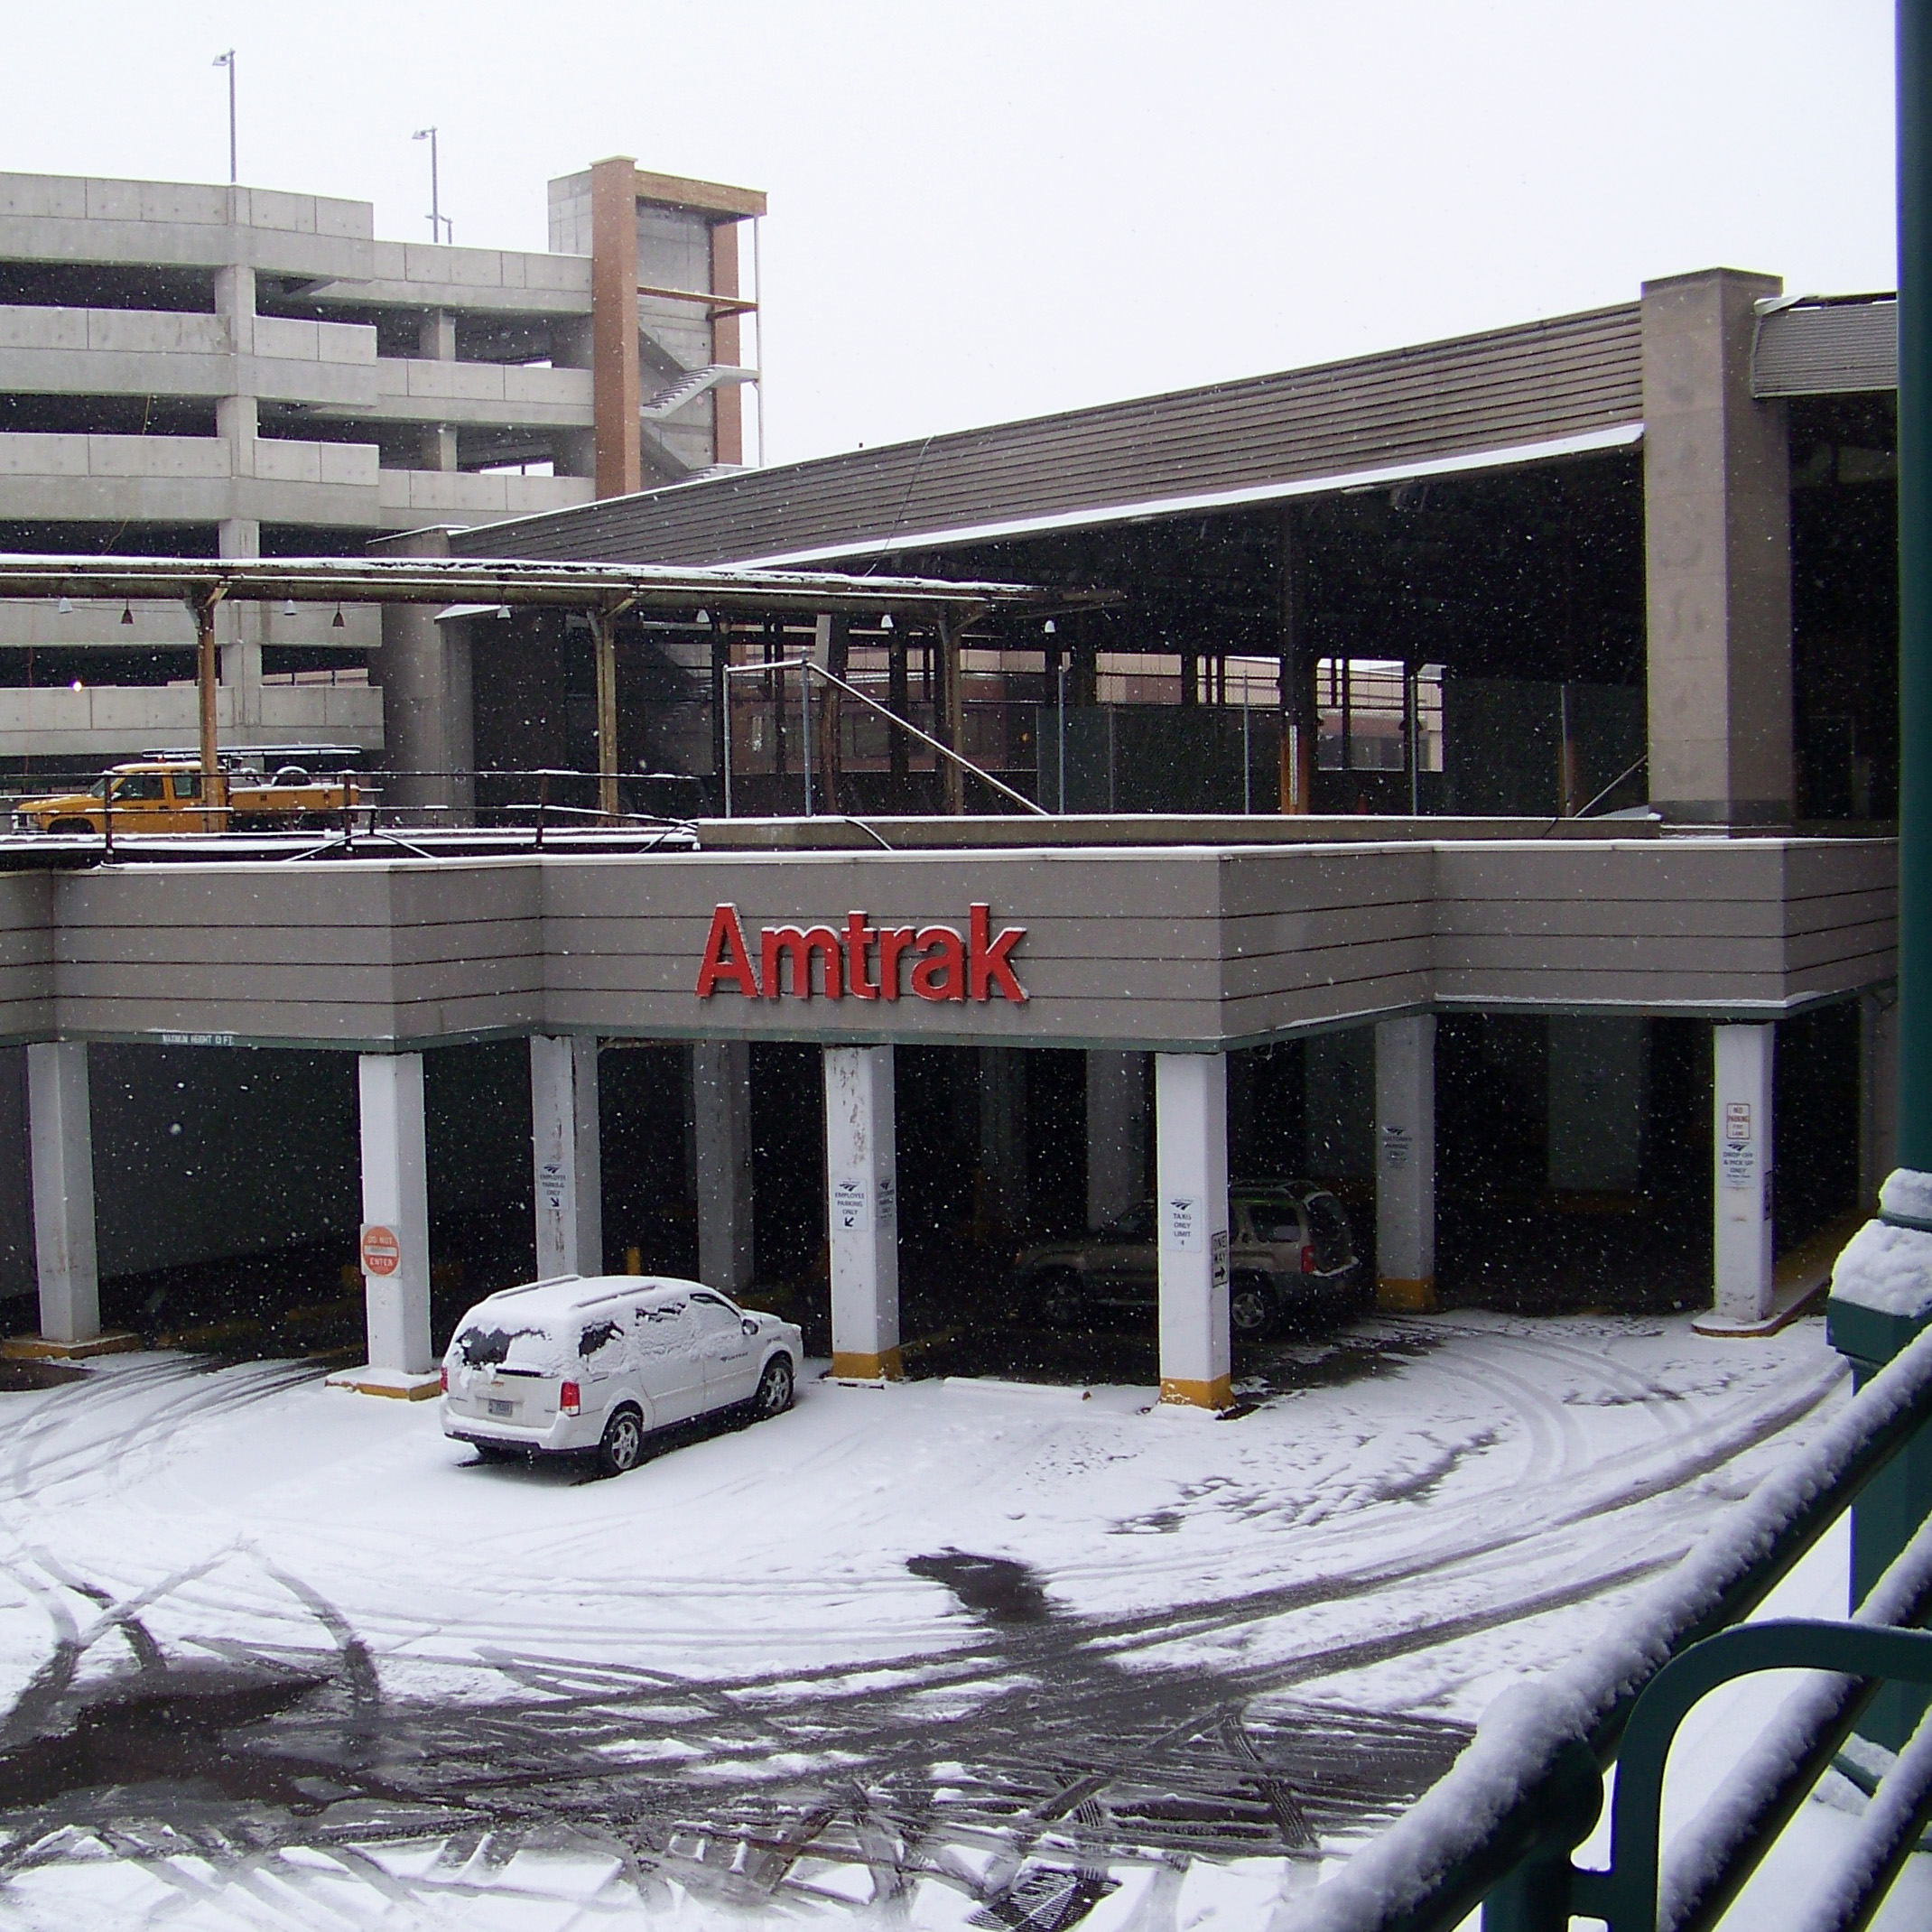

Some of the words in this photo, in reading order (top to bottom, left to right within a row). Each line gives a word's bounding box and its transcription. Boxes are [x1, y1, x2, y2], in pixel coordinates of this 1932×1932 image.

[695, 903, 1030, 1002] Amtrak
[1733, 1107, 1743, 1115] NO
[1173, 1212, 1192, 1221] TAXIS
[367, 1235, 377, 1244] DO
[379, 1237, 393, 1245] NOT
[370, 1257, 394, 1267] ENTER
